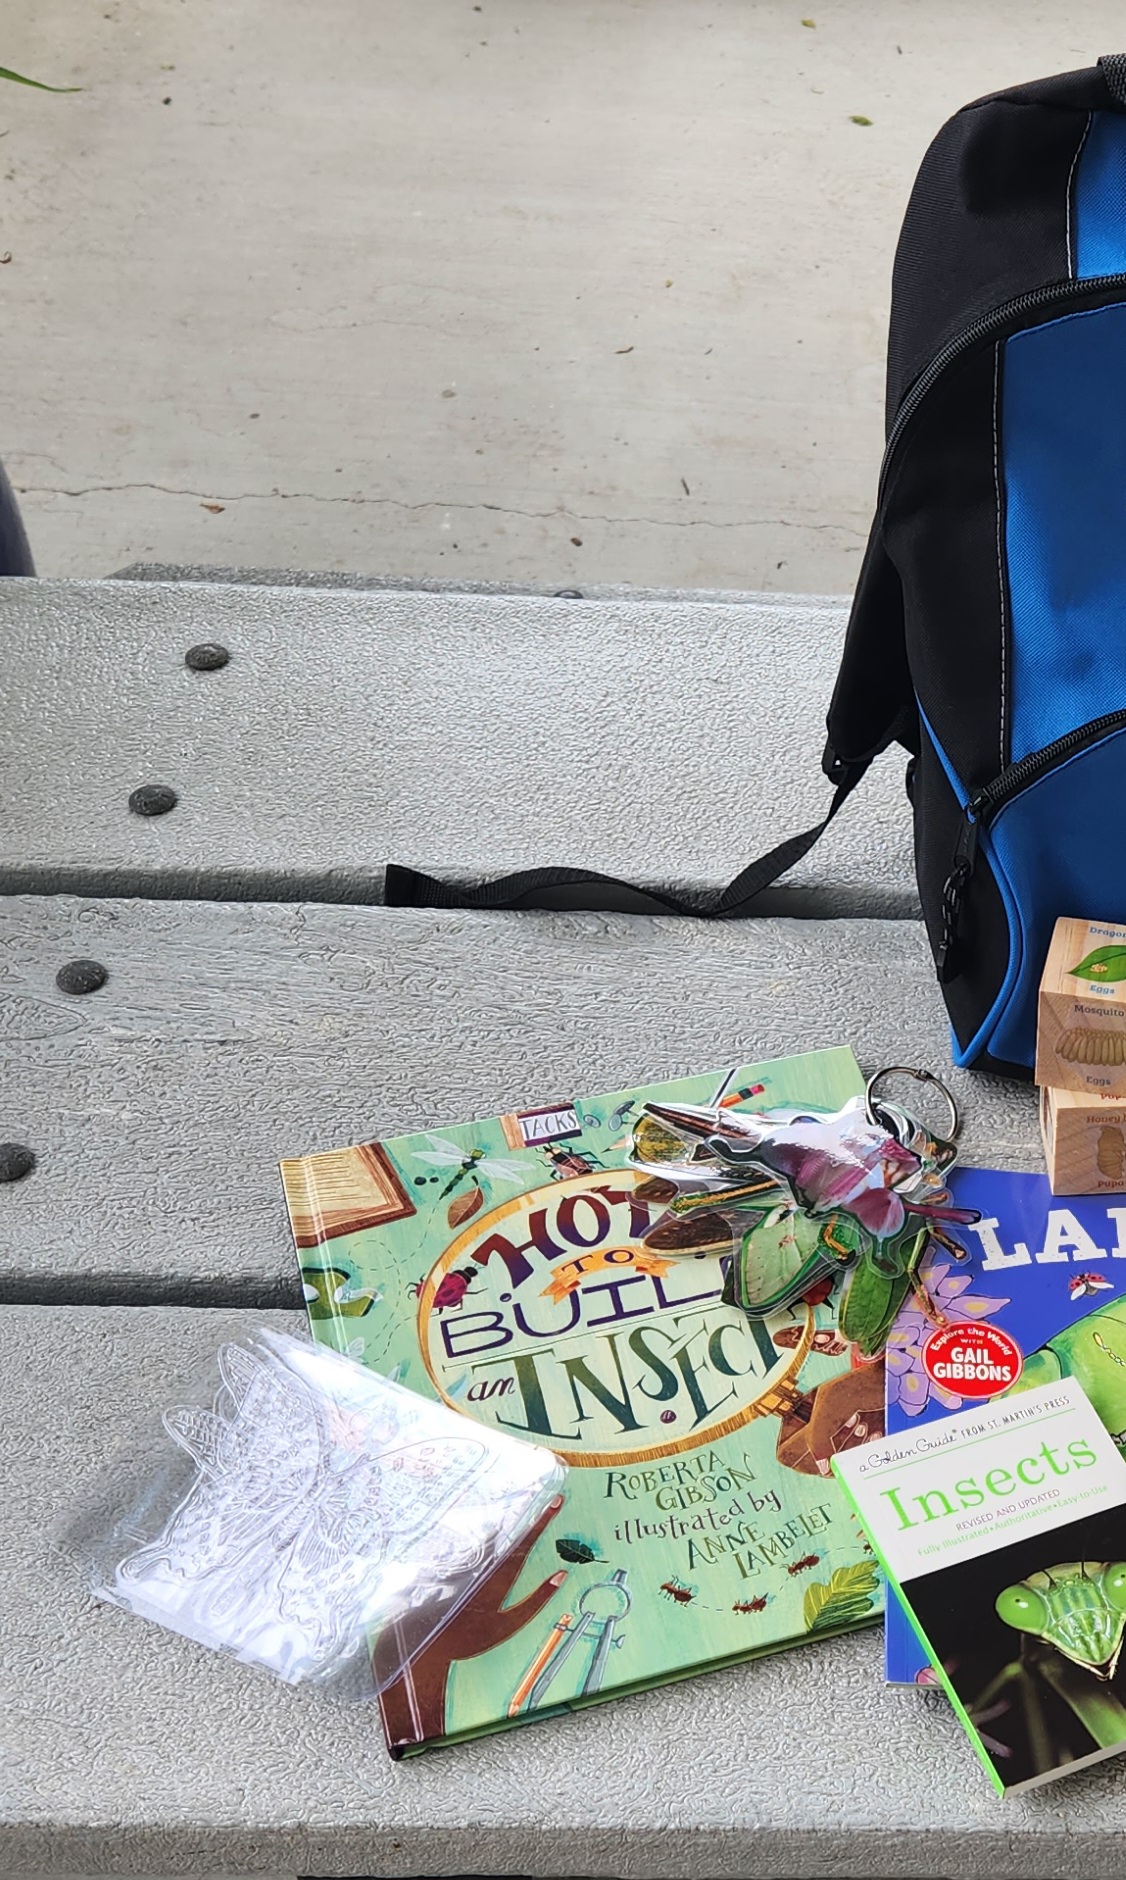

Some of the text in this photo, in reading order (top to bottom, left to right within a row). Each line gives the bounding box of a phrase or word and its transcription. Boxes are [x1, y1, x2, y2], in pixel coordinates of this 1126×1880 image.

[1089, 984, 1115, 996] Eggs
[1073, 1004, 1125, 1018] Mosquito
[1086, 1075, 1111, 1087] Eggs
[520, 1110, 577, 1140] TACKS
[1086, 1115, 1120, 1124] Honey
[1097, 1180, 1124, 1188] Pupa
[561, 1250, 635, 1275] TO
[440, 1257, 732, 1358] BUIL
[930, 1327, 1013, 1356] Explore the World
[951, 1347, 994, 1365] GAIL
[933, 1363, 1012, 1382] GIBBONS
[467, 1376, 516, 1402] an
[859, 1463, 869, 1473] a
[868, 1449, 917, 1468] Golden
[961, 1425, 986, 1440] FROM
[987, 1419, 1002, 1430] ST.
[1003, 1405, 1044, 1425] MARTIN'S
[1044, 1396, 1070, 1411] PRESS
[604, 1450, 726, 1501] ROBERTA
[655, 1452, 757, 1511] GIBSON
[880, 1439, 1098, 1532] Insects
[614, 1489, 782, 1544] illustrated by
[956, 1488, 1060, 1532] REVISED AND UPDATED
[688, 1520, 767, 1571] ANNE
[732, 1503, 834, 1580] LAMBELET
[917, 1544, 941, 1557] Fully
